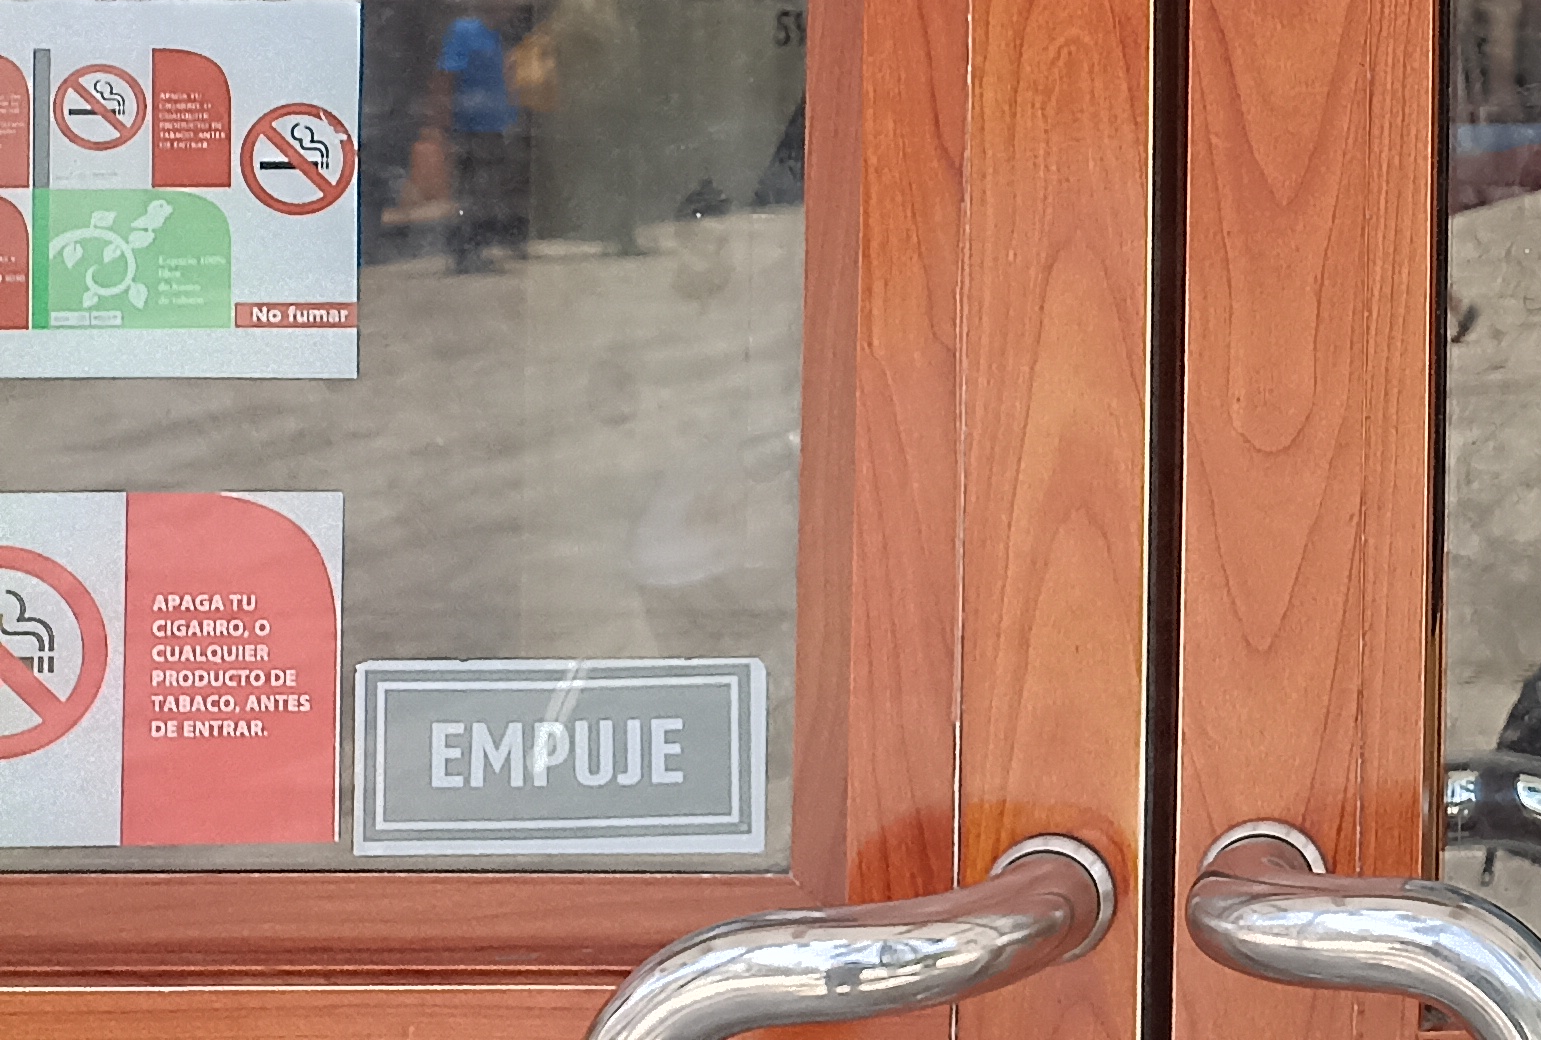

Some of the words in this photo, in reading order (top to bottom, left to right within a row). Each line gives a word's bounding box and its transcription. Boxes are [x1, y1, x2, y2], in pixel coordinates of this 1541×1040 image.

[252, 307, 282, 323] No
[288, 306, 348, 323] fumar
[152, 594, 224, 611] APAGA
[229, 594, 257, 611] TU
[152, 619, 249, 638] CIGARRO,
[254, 619, 271, 637] O
[151, 644, 269, 663] CUALQUIER
[151, 669, 266, 687] PRODUCTO
[270, 669, 297, 687] DE
[151, 694, 240, 714] TABACO,
[245, 694, 311, 712] ANTES
[150, 720, 178, 738] DE
[183, 720, 268, 738] ENTRAR.
[430, 717, 685, 789] EMPUJE
